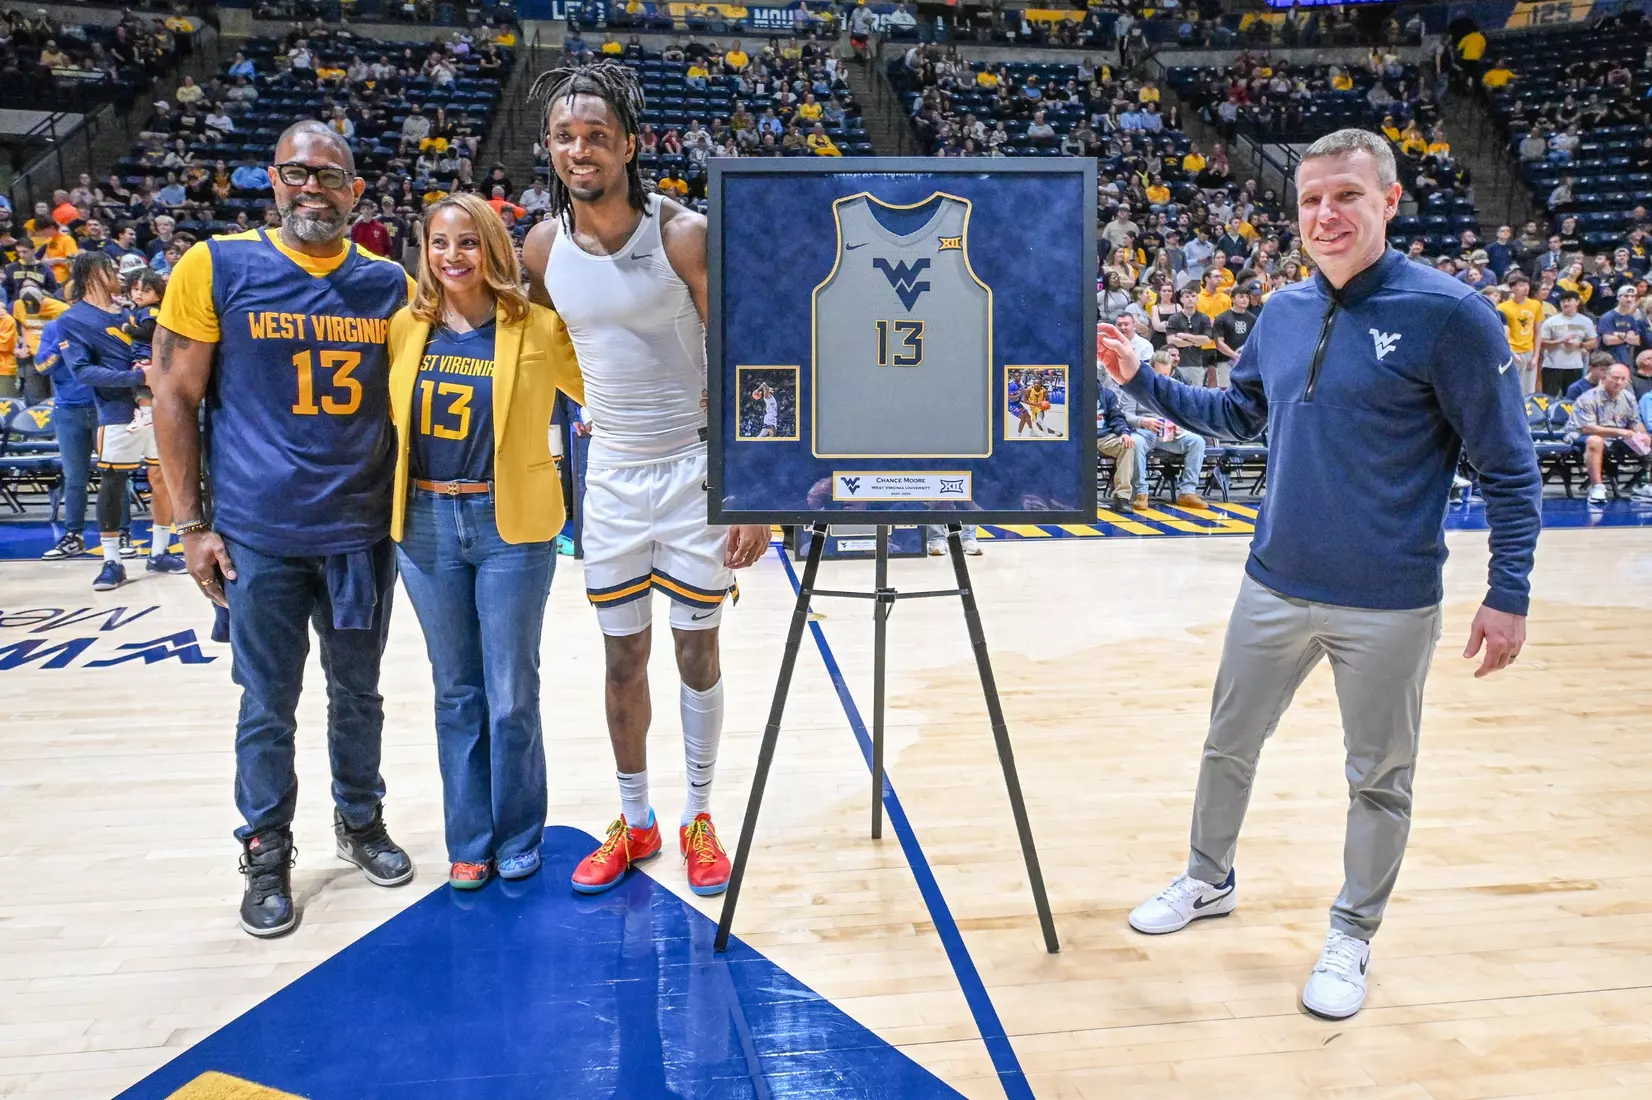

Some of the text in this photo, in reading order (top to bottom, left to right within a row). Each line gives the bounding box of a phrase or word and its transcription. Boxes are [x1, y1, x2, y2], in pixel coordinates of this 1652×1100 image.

[248, 311, 306, 340] WEST
[876, 320, 924, 367] 13
[292, 350, 363, 415] 13
[421, 354, 439, 371] ST
[420, 379, 474, 440] 13
